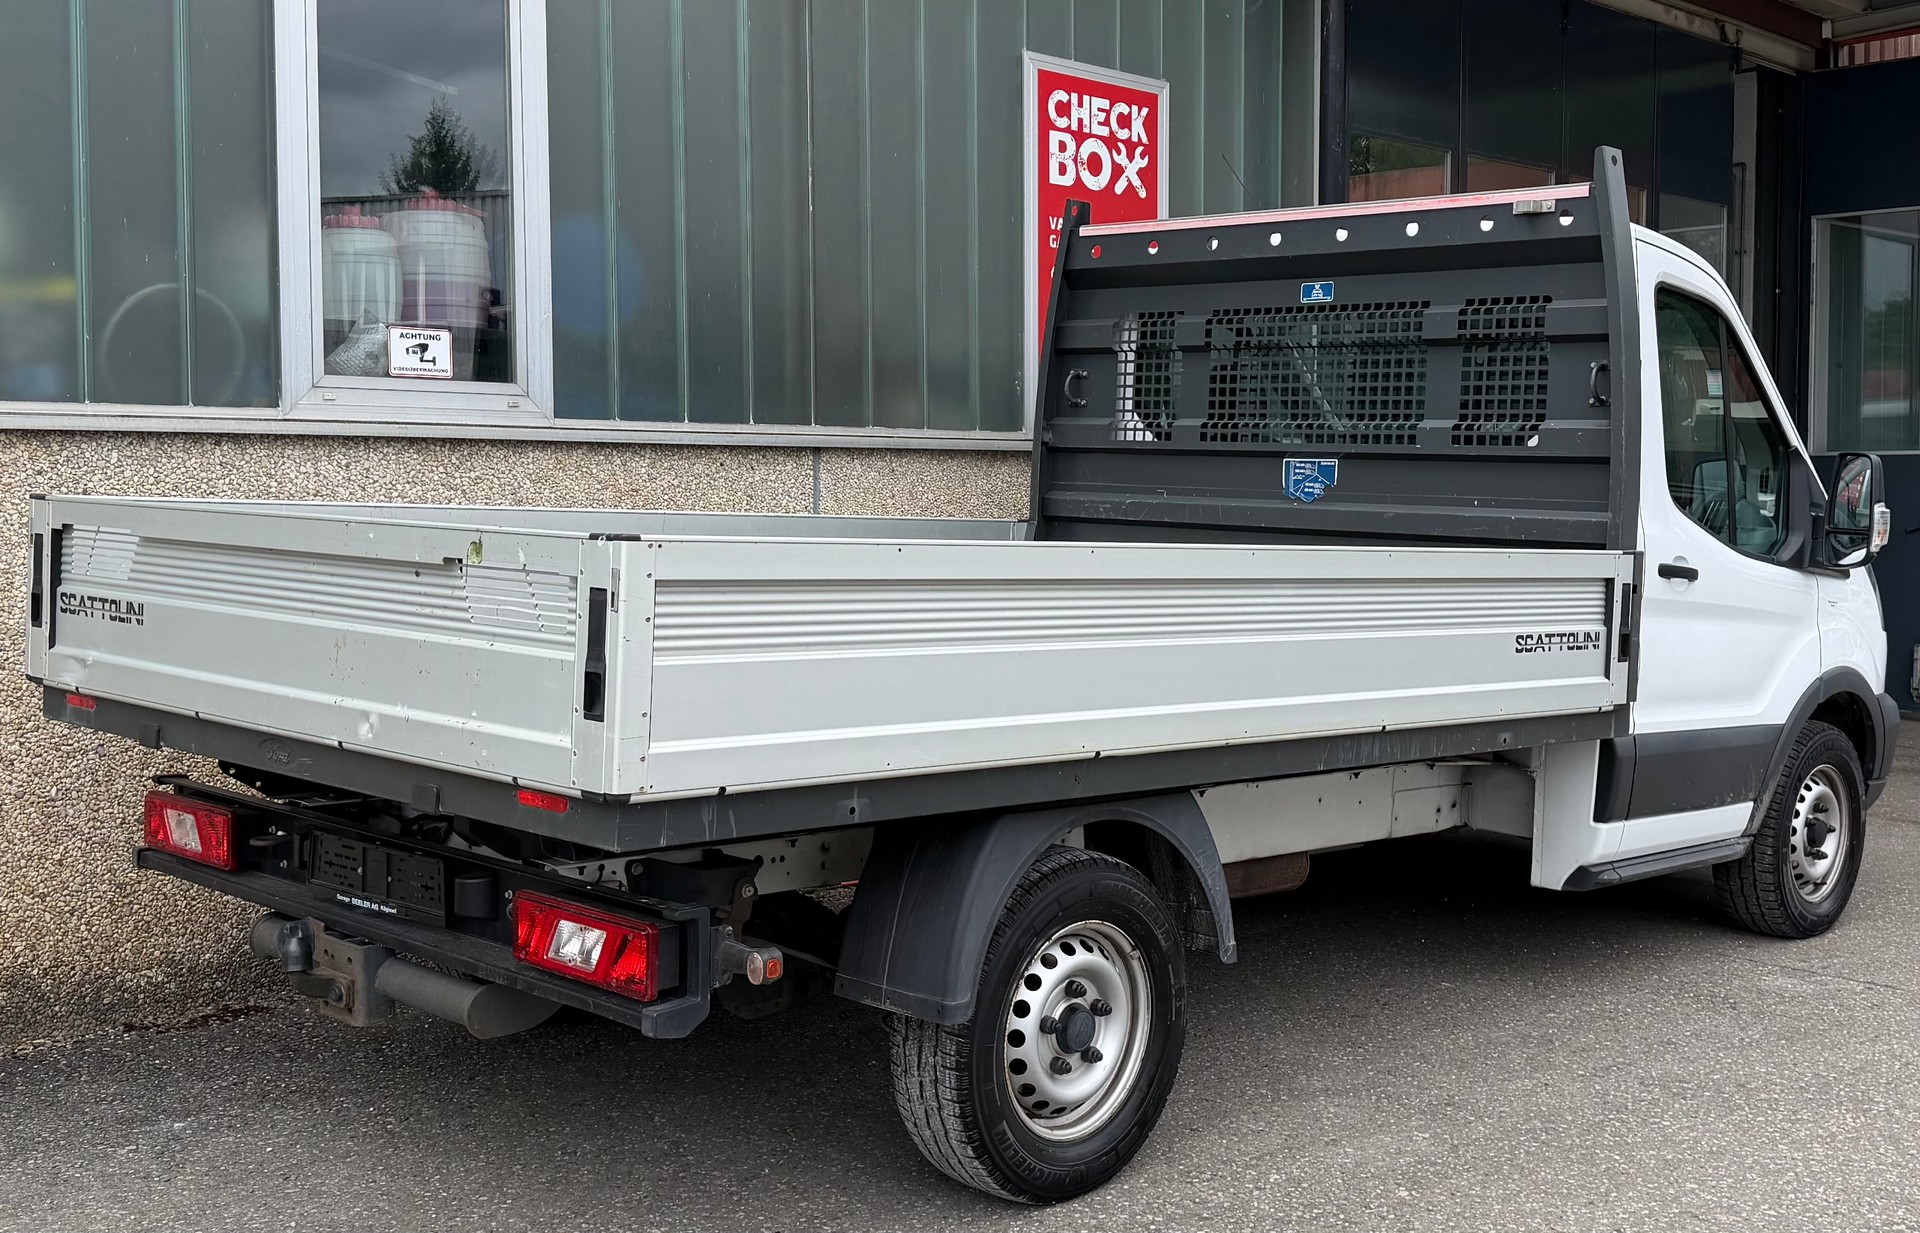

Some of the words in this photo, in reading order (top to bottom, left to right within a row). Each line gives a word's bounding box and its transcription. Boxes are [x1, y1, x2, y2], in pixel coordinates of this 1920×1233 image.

[1047, 89, 1150, 144] CHECK
[1049, 129, 1149, 199] BOX
[1049, 216, 1064, 231] VA
[399, 332, 441, 341] ACHTUNG
[60, 592, 144, 626] SCATTOLINI
[1515, 631, 1600, 653] SCATTOLINI
